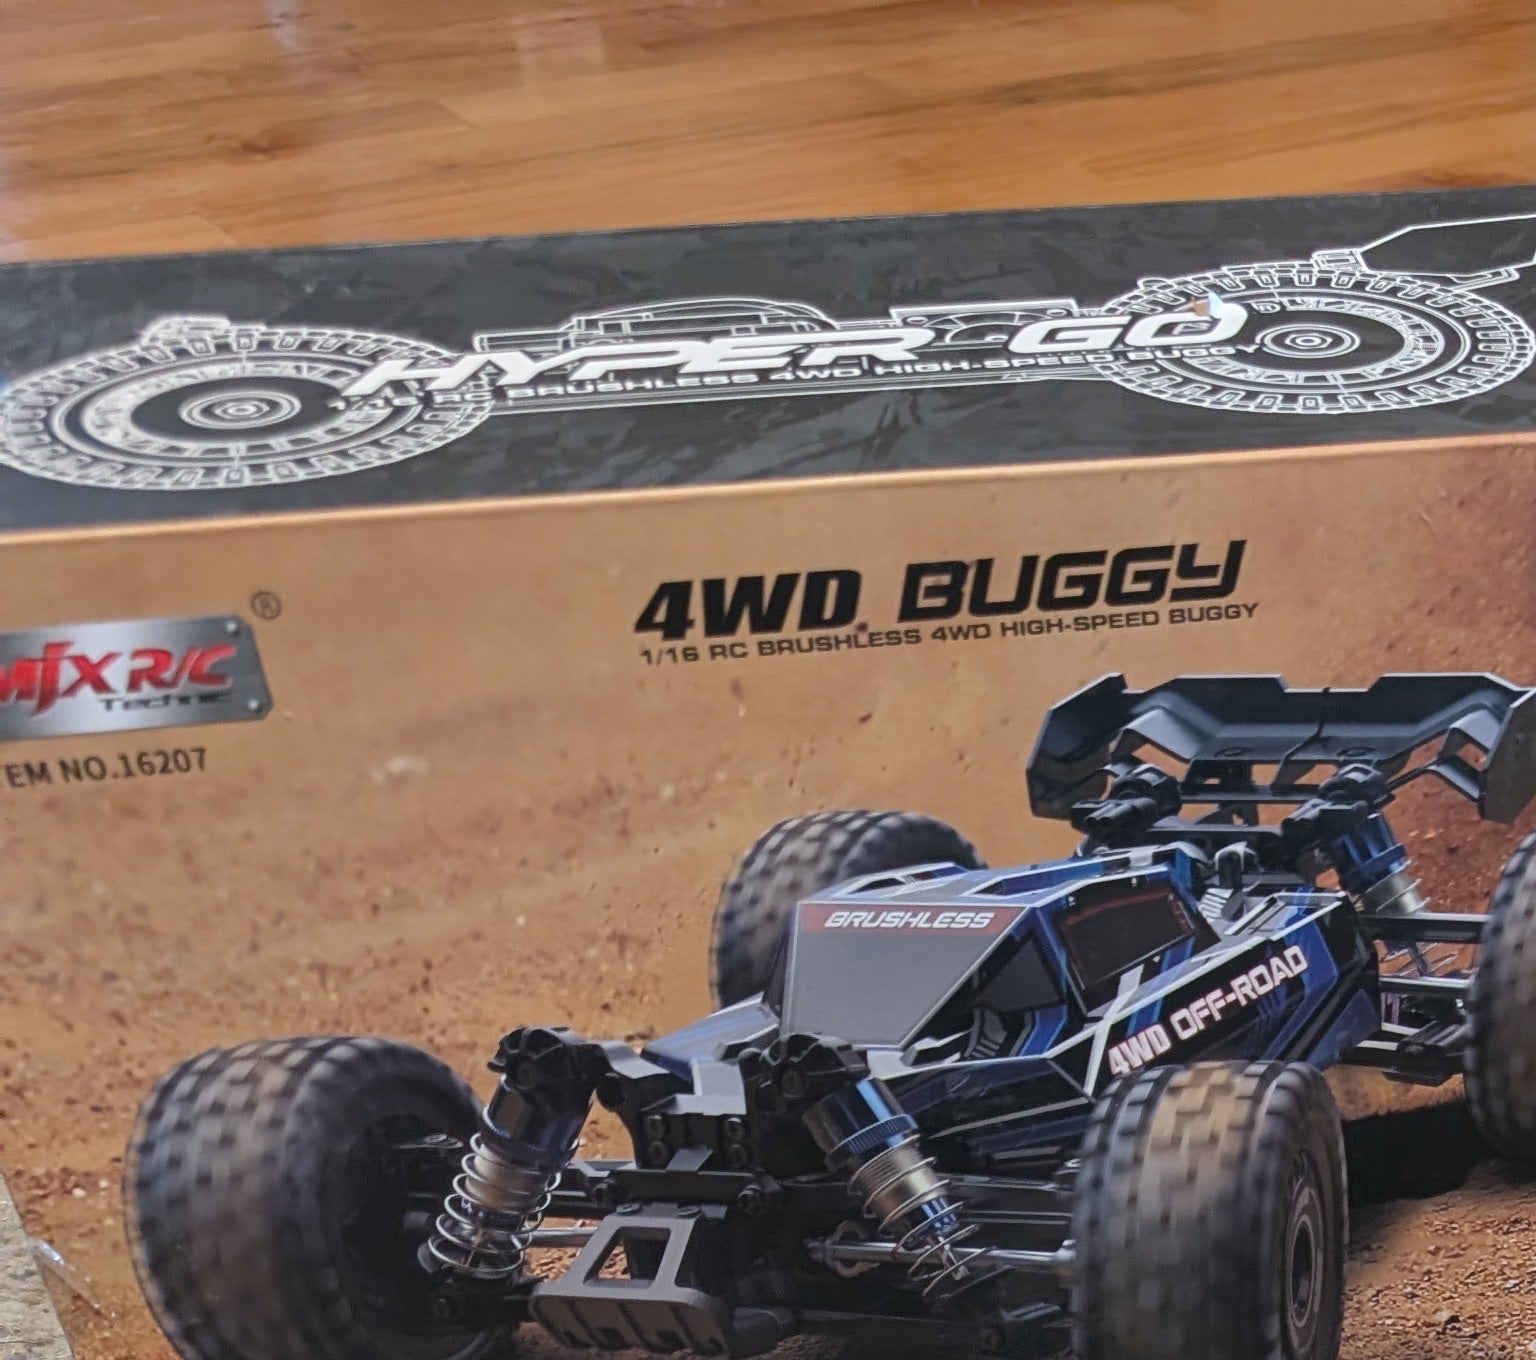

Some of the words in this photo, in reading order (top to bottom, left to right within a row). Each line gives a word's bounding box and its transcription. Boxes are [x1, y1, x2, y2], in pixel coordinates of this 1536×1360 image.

[342, 328, 934, 396] HYPER
[434, 391, 493, 403] RC
[507, 374, 759, 399] BRUSHLESS
[770, 368, 863, 381] 4WD
[874, 355, 1122, 376] HIGH-SPEED
[1128, 344, 1261, 361] BUGGY
[634, 569, 862, 641] 4WD
[897, 540, 1247, 623] BUGGY
[640, 646, 699, 666] 1/16
[709, 642, 748, 661] RC
[758, 628, 922, 657] BRUSHLESS
[931, 623, 991, 642] 4WD
[1000, 608, 1159, 637] HIGH-SPEED
[1169, 602, 1259, 624] BUGGY
[58, 747, 207, 783] NO.16207
[824, 910, 995, 930] BRUSHLESS
[1108, 1025, 1171, 1078] 4WD
[1171, 945, 1308, 1040] OFF-ROAD
